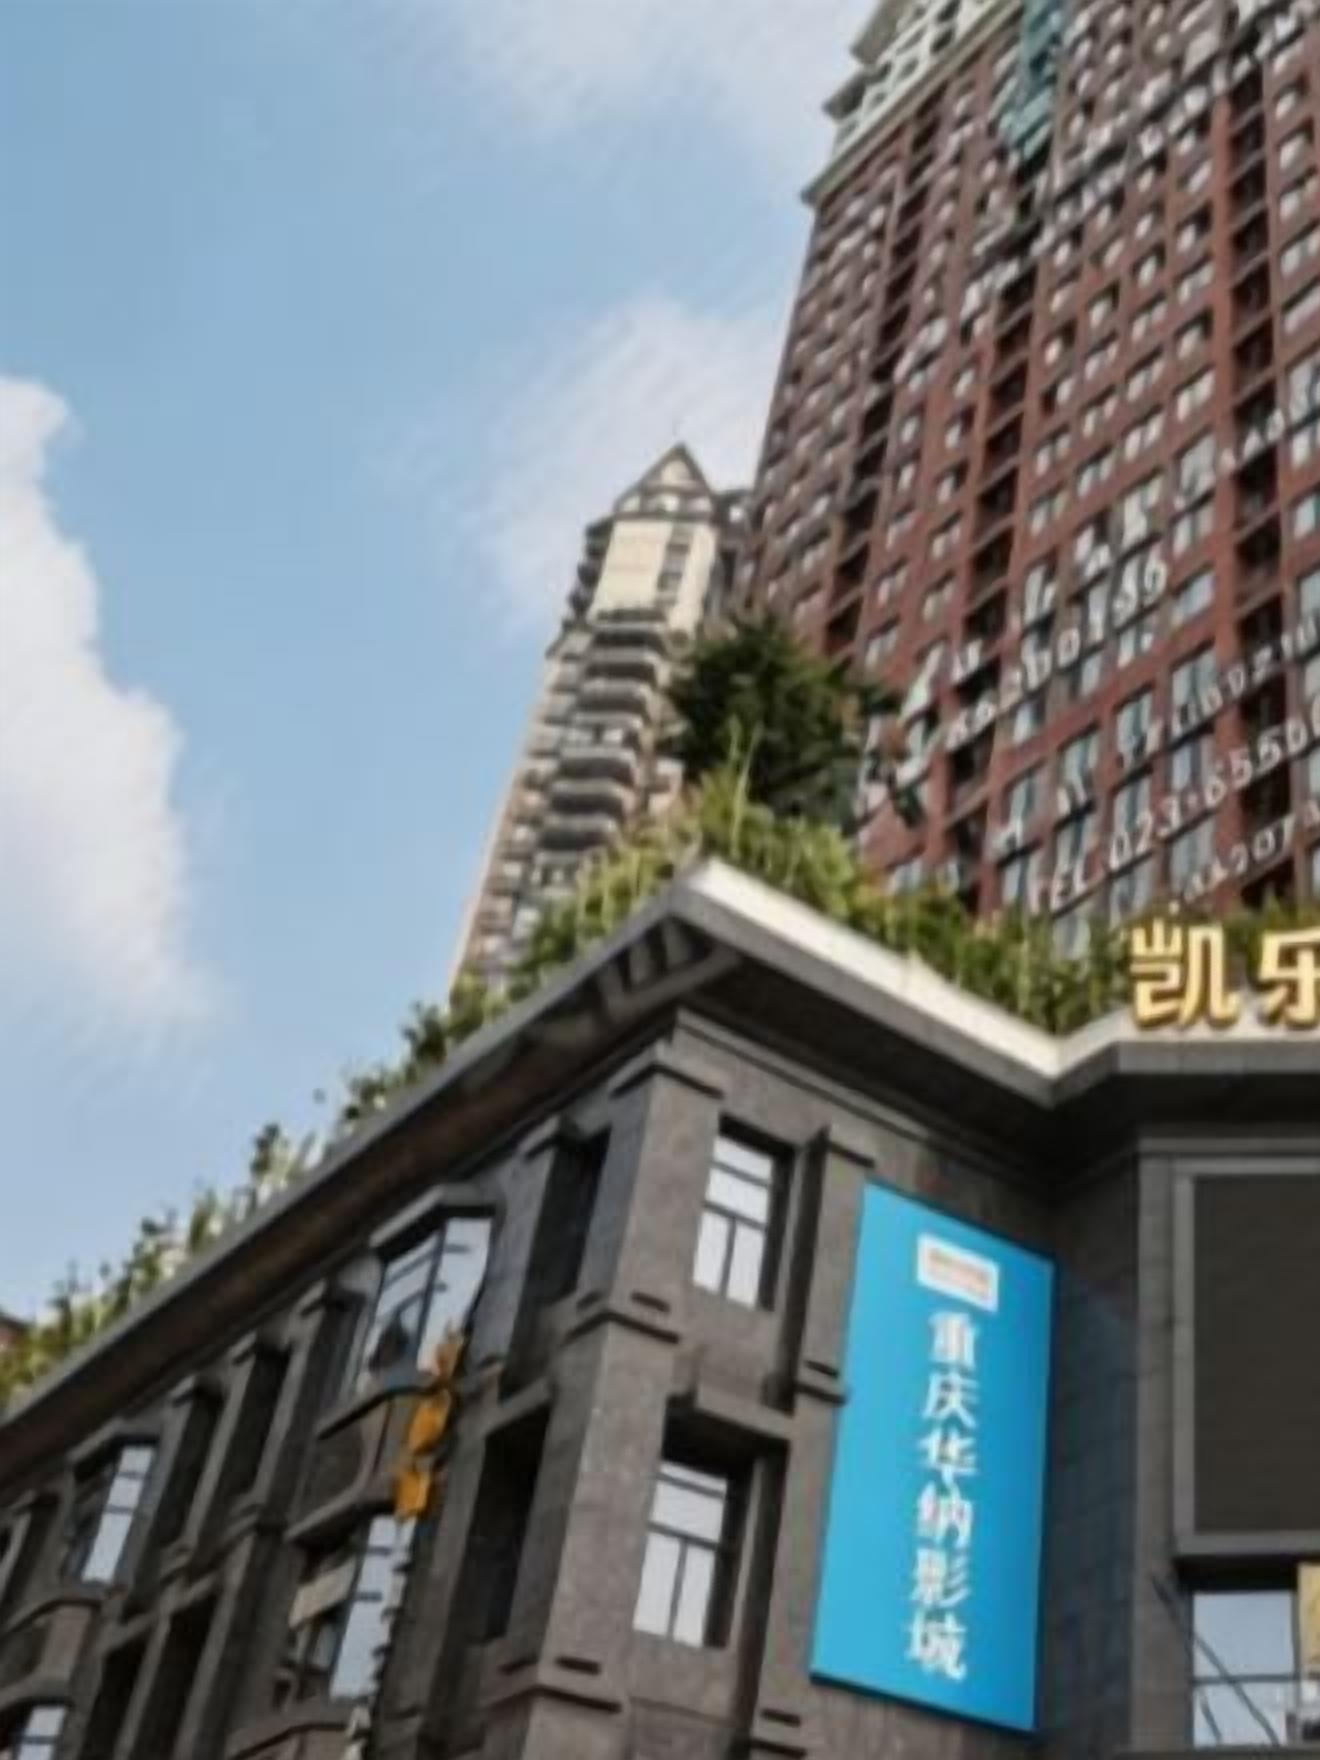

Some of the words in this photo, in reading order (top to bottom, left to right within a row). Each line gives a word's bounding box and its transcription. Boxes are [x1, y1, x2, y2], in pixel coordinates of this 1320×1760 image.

[905, 1311, 979, 1682] 重庆华纳影城
